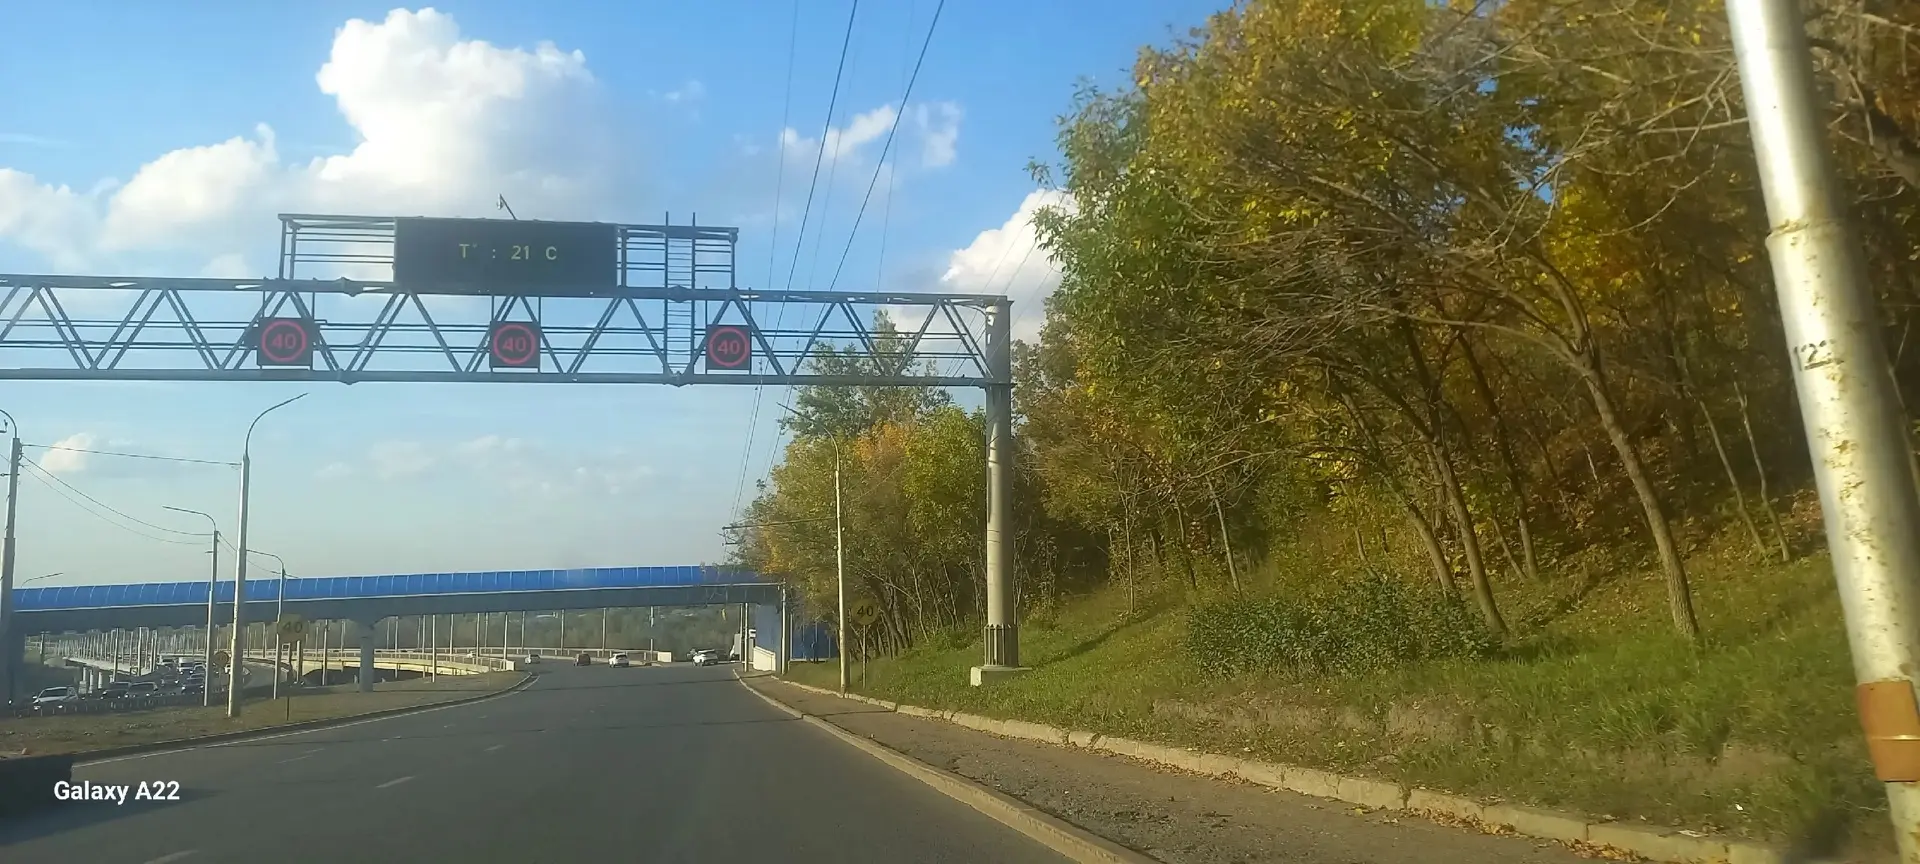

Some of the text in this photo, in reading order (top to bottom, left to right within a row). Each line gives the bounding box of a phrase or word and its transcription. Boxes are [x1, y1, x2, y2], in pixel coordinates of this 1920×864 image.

[511, 245, 530, 260] 21
[545, 246, 557, 260] C
[271, 333, 296, 349] 40
[503, 336, 527, 352] 40
[718, 340, 740, 355] 40
[857, 604, 874, 617] 40
[283, 621, 303, 634] 40
